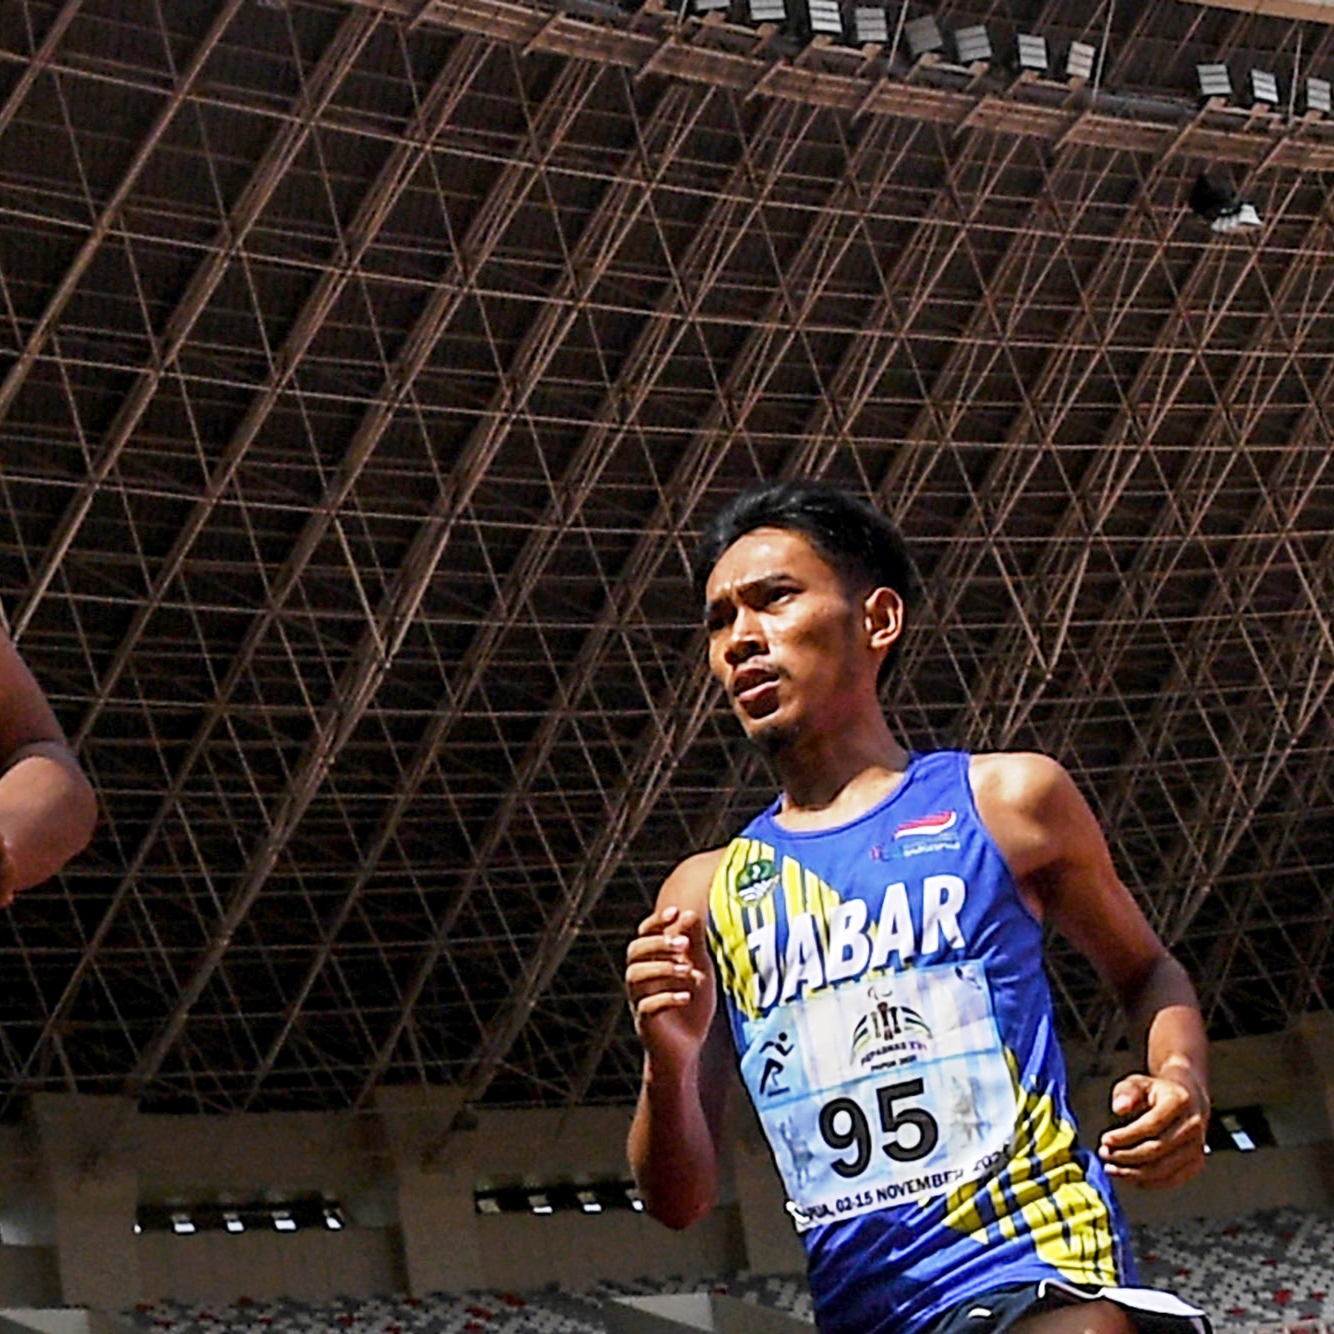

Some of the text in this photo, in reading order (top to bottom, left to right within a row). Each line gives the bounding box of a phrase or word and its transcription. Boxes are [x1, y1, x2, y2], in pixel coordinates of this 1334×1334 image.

[748, 873, 967, 1009] JABAR
[818, 1078, 939, 1179] 95
[836, 1190, 873, 1213] 02-15
